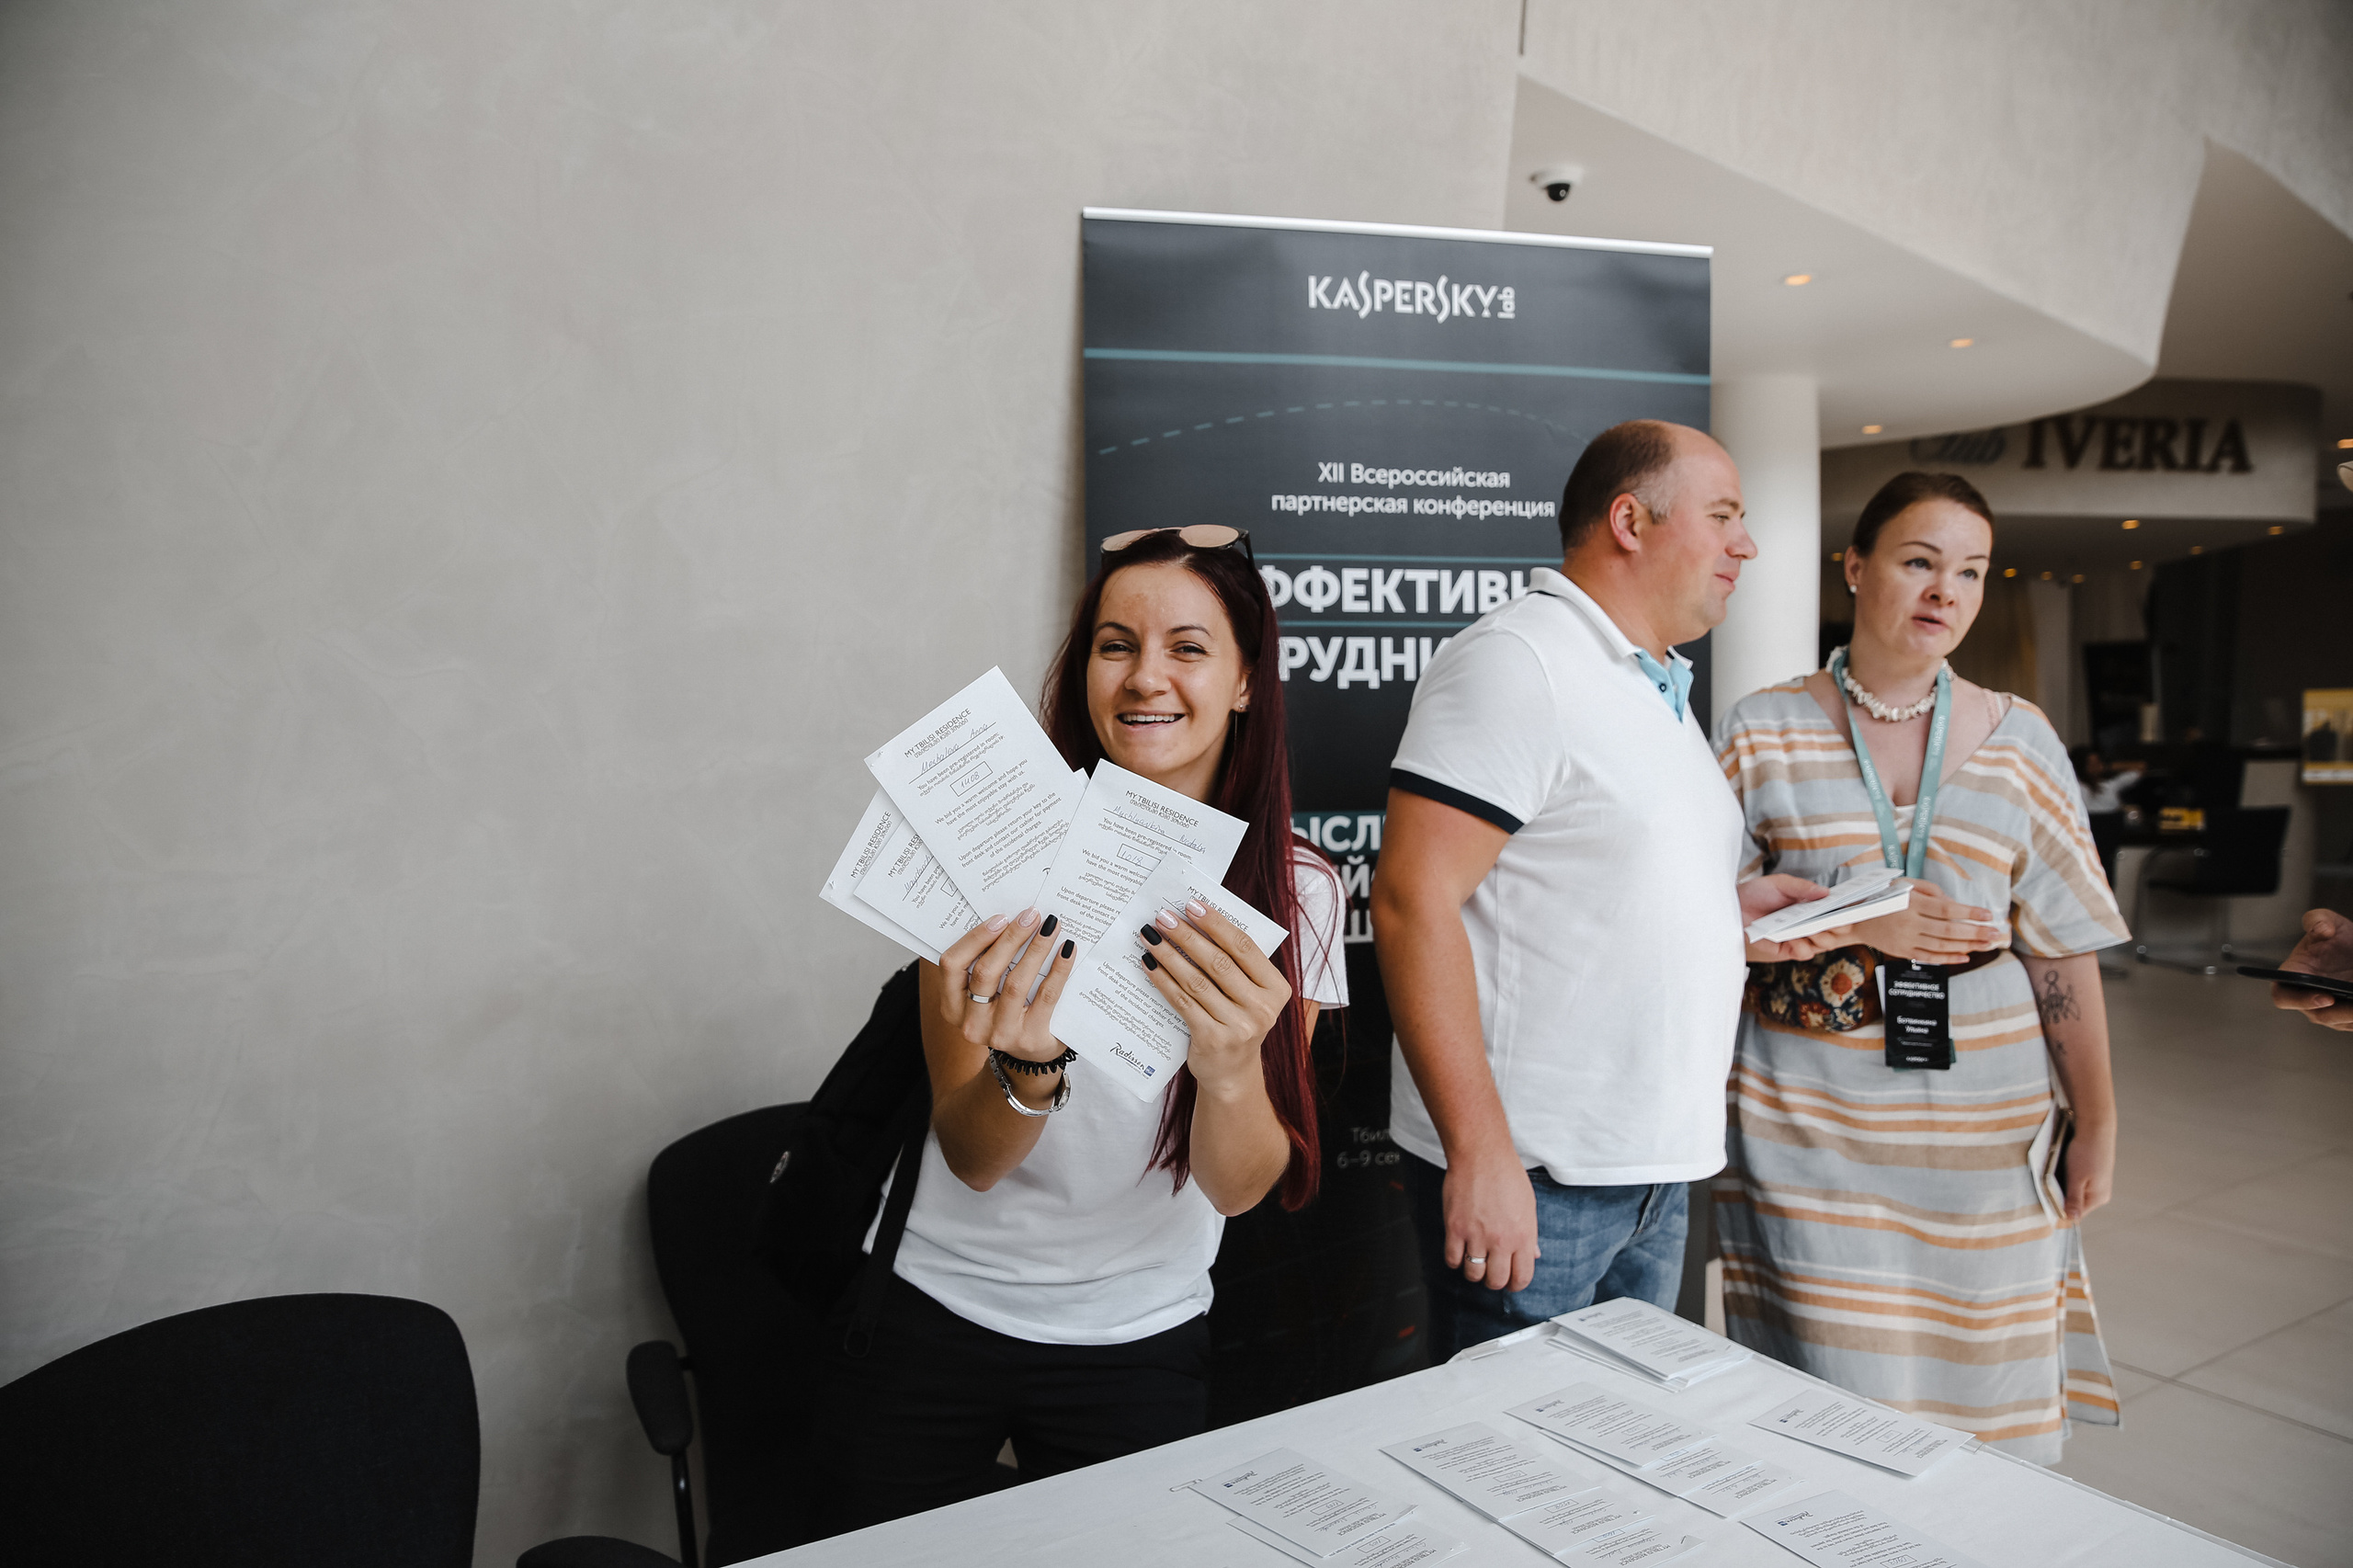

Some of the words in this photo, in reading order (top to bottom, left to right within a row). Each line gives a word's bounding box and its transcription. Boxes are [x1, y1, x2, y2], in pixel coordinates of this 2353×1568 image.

[1308, 269, 1498, 324] KASPERSKY
[2022, 415, 2254, 473] IVERIA
[1350, 462, 1511, 489] Всероссийская
[1271, 494, 1408, 517] партнерская
[1413, 495, 1555, 520] конференция
[1258, 565, 1529, 614] ФФЕКТИВ
[904, 746, 915, 758] MY
[914, 733, 937, 750] TBILISI
[935, 708, 972, 736] RESIDENCE
[916, 782, 928, 790] You
[926, 775, 938, 785] have
[937, 767, 950, 778] been
[949, 744, 981, 770] pre-registered
[984, 732, 1000, 744] room:
[943, 810, 952, 819] bid
[951, 805, 961, 815] you
[963, 793, 979, 804] warm
[977, 779, 998, 795] welcome
[997, 772, 1007, 782] and
[1005, 765, 1019, 776] hope
[1017, 758, 1029, 768] you
[945, 816, 958, 826] have
[957, 811, 966, 819] the
[965, 802, 978, 813] most
[977, 789, 998, 805] enjoyable
[997, 781, 1007, 790] stay
[1006, 774, 1018, 784] with
[1125, 790, 1138, 800] MY
[1138, 794, 1160, 810] TBILISI
[1159, 805, 1199, 827] RESIDENCE
[850, 866, 859, 879] MY
[855, 846, 871, 868] TBILISI
[867, 811, 892, 848] RESIDENCE
[958, 850, 972, 861] Upon
[972, 835, 995, 853] departure
[993, 825, 1008, 839] please
[1007, 815, 1023, 828] return
[1021, 807, 1033, 819] your
[1031, 801, 1042, 810] key
[961, 858, 974, 869] front
[973, 850, 985, 860] desk
[984, 843, 994, 853] and
[993, 833, 1011, 846] contact
[1009, 826, 1018, 835] our
[1018, 815, 1035, 829] cashier
[1033, 810, 1042, 818] for
[1041, 797, 1062, 814] payment
[995, 846, 1004, 855] the
[1002, 831, 1025, 849] incidental
[1024, 820, 1043, 835] charges.
[1103, 817, 1113, 825] You
[1112, 822, 1125, 831] have
[1124, 826, 1137, 836] been
[1136, 833, 1173, 852] pre-registered
[888, 866, 898, 878] MY
[893, 846, 912, 868] TBILISI
[1082, 848, 1091, 857] We
[1091, 852, 1100, 860] bid
[1114, 863, 1129, 872] warm
[1129, 869, 1149, 881] welcom
[1086, 858, 1097, 868] have
[1107, 868, 1120, 877] most
[911, 894, 921, 903] You
[916, 884, 927, 895] have
[924, 873, 935, 885] been
[1056, 892, 1070, 902] front
[1069, 898, 1082, 906] desk
[1091, 907, 1110, 919] contact
[1061, 885, 1075, 896] Upon
[1074, 892, 1099, 906] departure
[1098, 903, 1116, 913] please
[1094, 915, 1113, 927] inciden
[1187, 886, 1199, 896] MY
[1215, 906, 1249, 932] RESIDENCE
[1097, 966, 1108, 978] front
[1108, 975, 1120, 985] desk
[1118, 983, 1129, 992] and
[1127, 989, 1144, 1004] contact
[1142, 1001, 1153, 1009] our
[1151, 1007, 1167, 1020] cashier
[1166, 1017, 1175, 1026] for
[1102, 960, 1116, 973] Upon
[1115, 971, 1137, 989] departure
[1134, 987, 1150, 999] please
[1149, 996, 1164, 1009] return
[1120, 993, 1129, 1001] the
[1127, 998, 1150, 1016] incidental
[1147, 1014, 1165, 1029] charges.
[1109, 1041, 1144, 1071] Radisson
